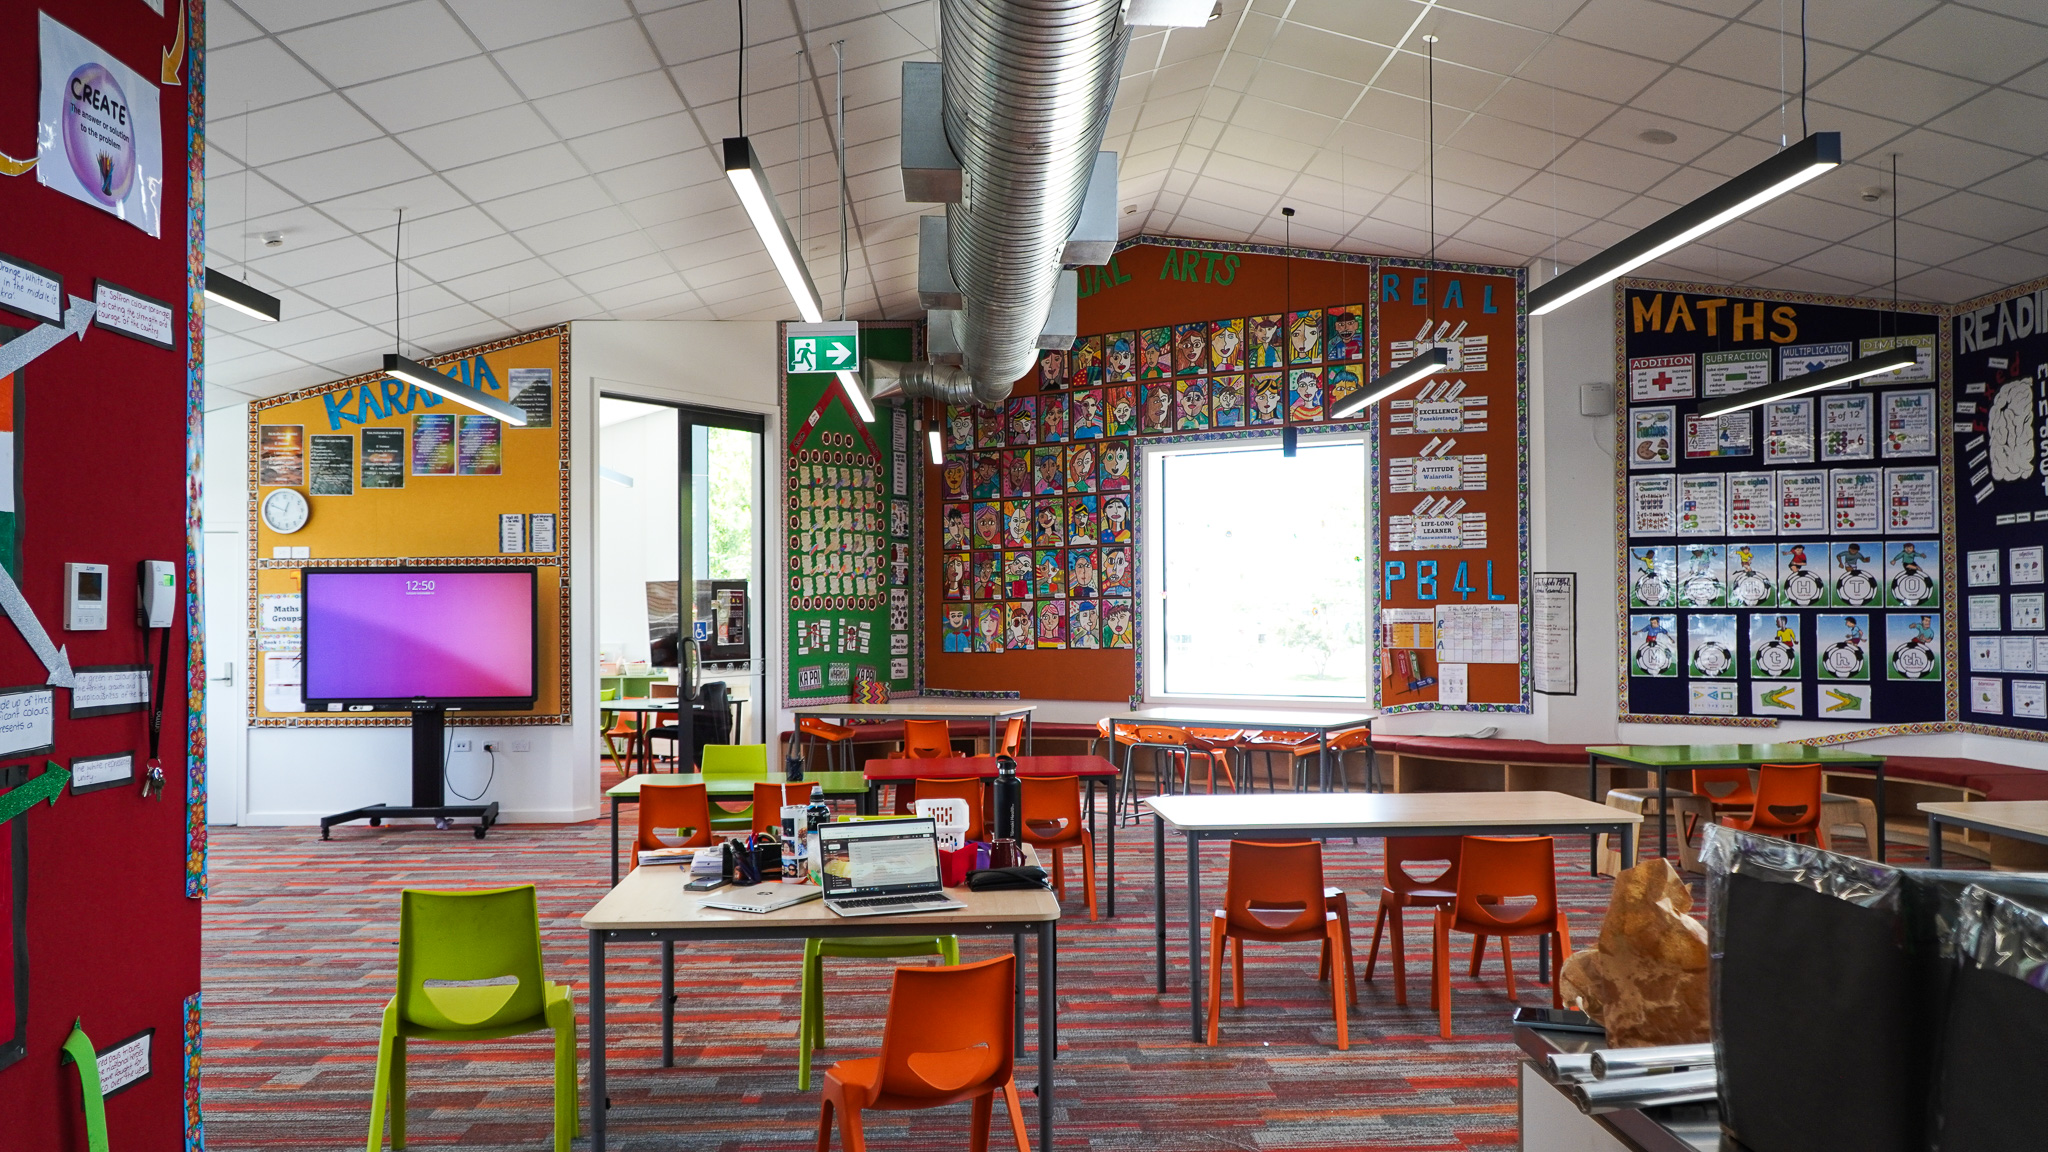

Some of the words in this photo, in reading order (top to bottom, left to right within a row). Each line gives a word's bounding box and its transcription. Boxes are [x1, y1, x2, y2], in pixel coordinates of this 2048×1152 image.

[70, 78, 126, 126] CREATE
[82, 111, 102, 126] answer
[109, 126, 130, 143] solution
[88, 127, 98, 139] the
[99, 134, 121, 150] problem
[1160, 249, 1241, 286] ARTS
[1632, 294, 1798, 344] MATHS
[1864, 338, 1931, 350] DIVISION
[1783, 345, 1848, 356] MULTIPLICATION
[1632, 356, 1692, 368] ADDITION
[1706, 352, 1768, 363] SUBTRACTION
[1847, 400, 1865, 410] half
[1895, 396, 1922, 407] third
[1775, 404, 1800, 415] half
[1720, 416, 1729, 428] 3
[1838, 412, 1846, 421] of
[1689, 424, 1697, 435] 3
[1720, 430, 1729, 442] 4
[1858, 434, 1864, 445] 6
[1689, 436, 1698, 449] 4
[1747, 478, 1768, 488] eighth
[1856, 476, 1874, 486] fifth
[1897, 473, 1925, 483] quarter
[406, 580, 435, 591] 12:50
[1385, 560, 1505, 600] PB4L
[1797, 580, 1811, 594] H
[1850, 580, 1864, 593] T
[1770, 652, 1781, 664] t
[1836, 653, 1849, 666] h
[1904, 653, 1923, 666] th
[800, 671, 808, 686] KA
[809, 670, 821, 685] PAI
